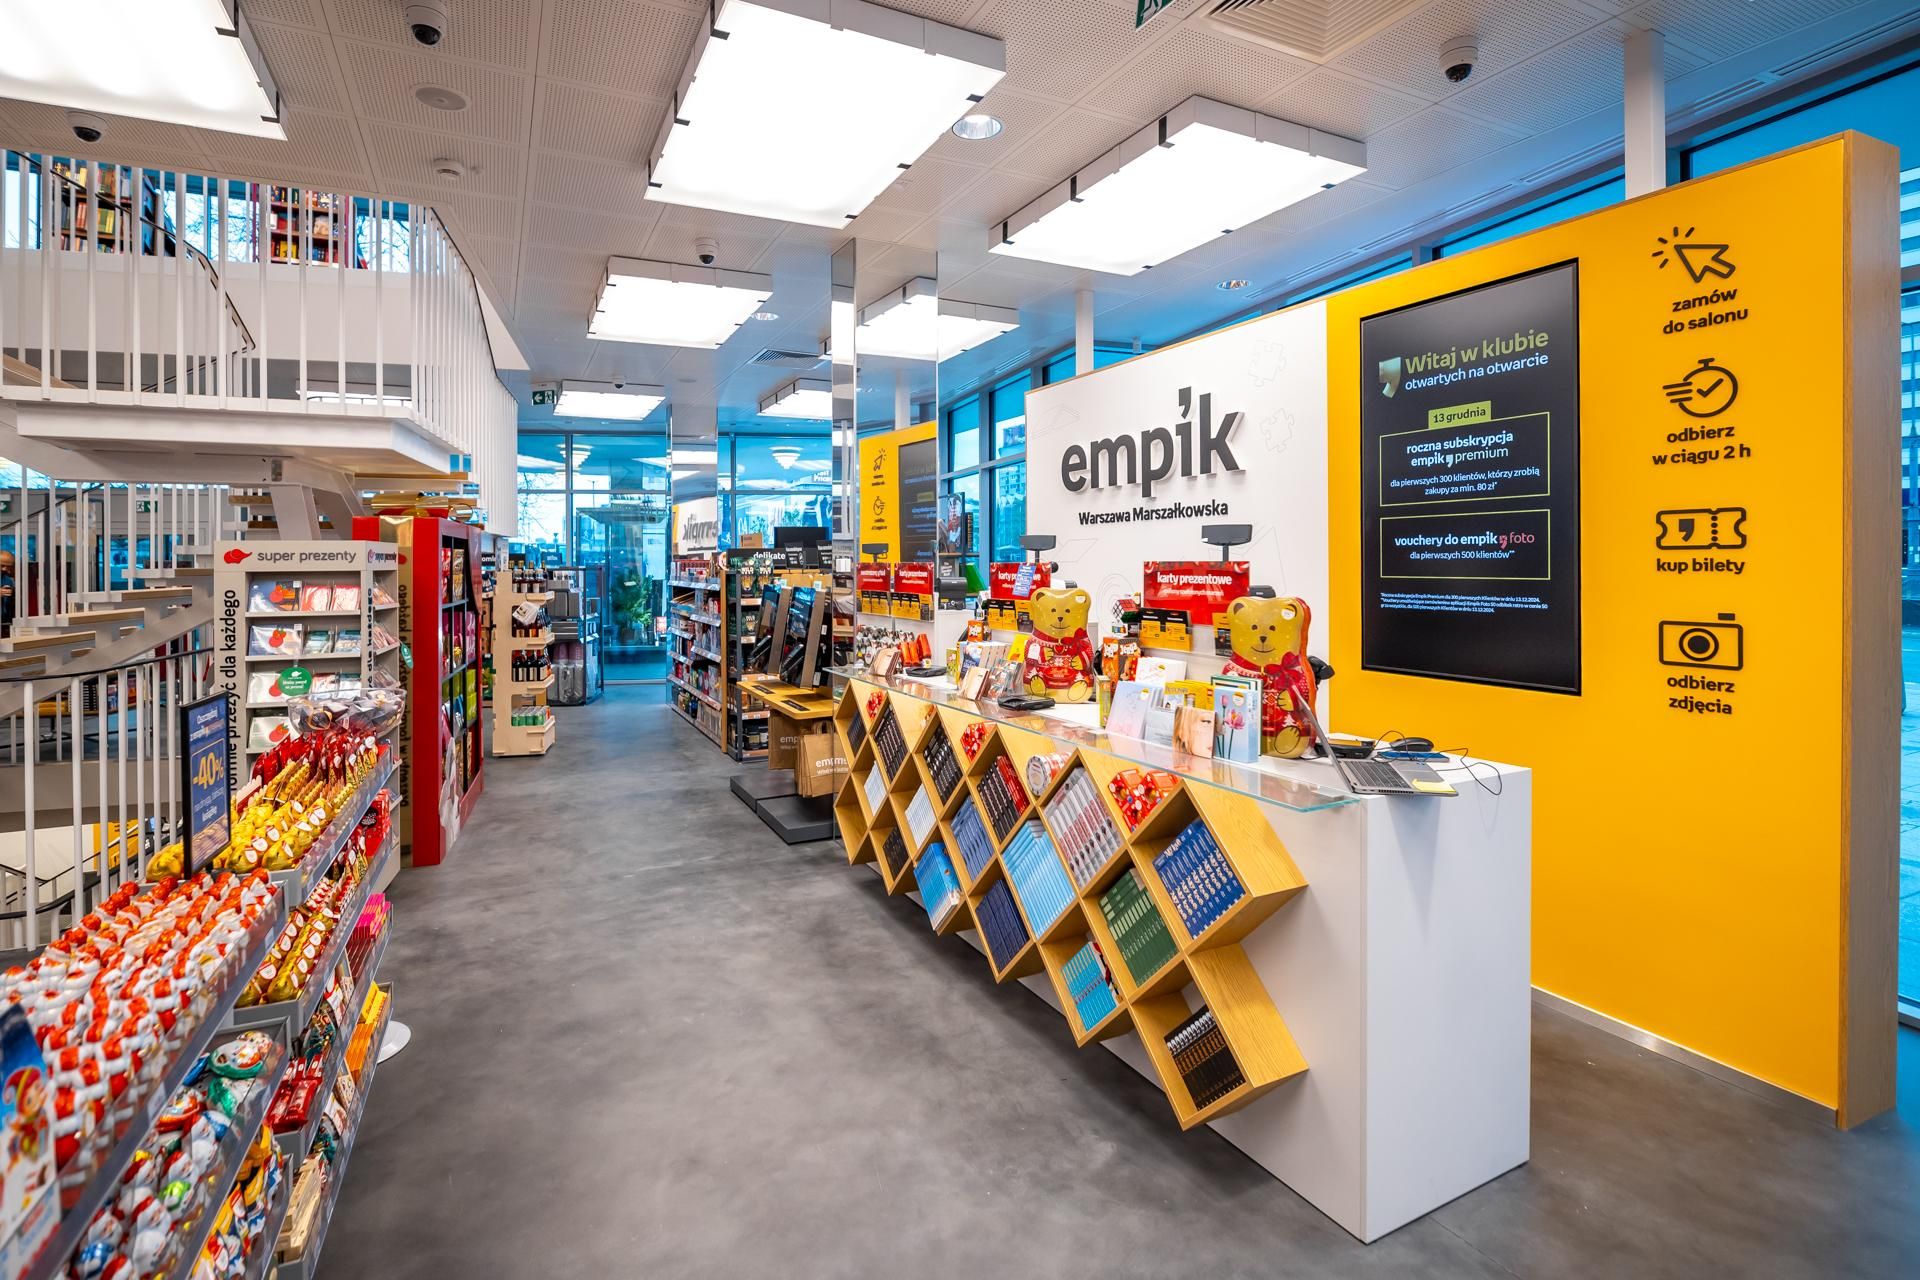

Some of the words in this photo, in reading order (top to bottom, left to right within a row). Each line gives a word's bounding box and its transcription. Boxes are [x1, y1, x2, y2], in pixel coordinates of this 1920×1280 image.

[1672, 289, 1738, 312] zamów
[1663, 320, 1685, 334] do
[1688, 309, 1749, 330] salonu
[1405, 346, 1456, 374] Witaj
[1460, 346, 1479, 363] w
[1482, 329, 1549, 359] klubie
[1405, 368, 1466, 390] otwartych
[1469, 367, 1485, 379] na
[1487, 353, 1549, 375] otwarcie
[1433, 413, 1445, 423] 13
[1446, 407, 1486, 423] grudnia
[1061, 386, 1243, 498] empik
[1407, 442, 1442, 454] roczna
[1444, 430, 1514, 450] subskrypcja
[1667, 425, 1735, 443] odbierz
[1411, 452, 1445, 467] empik
[1455, 446, 1509, 465] premium
[1652, 454, 1667, 465] w
[1671, 449, 1720, 465] ciągu
[1724, 445, 1735, 459] 2
[1739, 444, 1751, 458] h
[1390, 479, 1401, 487] dla
[1401, 474, 1439, 488] pierwszych
[1440, 475, 1453, 483] 300
[1488, 470, 1513, 480] którzy
[1514, 467, 1540, 477] zrobią
[1425, 485, 1450, 496] zakupy
[1460, 484, 1476, 492] min.
[1477, 483, 1487, 491] 80
[1079, 511, 1131, 525] Warszawa
[1133, 499, 1229, 521] Marszałkowska
[1395, 534, 1443, 547] vouchery
[1444, 534, 1459, 545] do
[1461, 531, 1498, 547] empik
[1510, 532, 1535, 544] foto
[257, 551, 295, 563] super
[299, 550, 357, 563] prezenty
[1421, 551, 1461, 560] pierwszych
[1462, 551, 1475, 559] 500
[1657, 558, 1688, 574] kup
[1692, 558, 1745, 575] bilety
[1157, 572, 1179, 585] karty
[1179, 574, 1233, 586] prezentowe
[219, 590, 241, 651] każdego
[219, 656, 237, 679] dla
[1667, 675, 1735, 693] odbierz
[1669, 696, 1733, 715] zdjęcia
[193, 752, 225, 791] -40%
